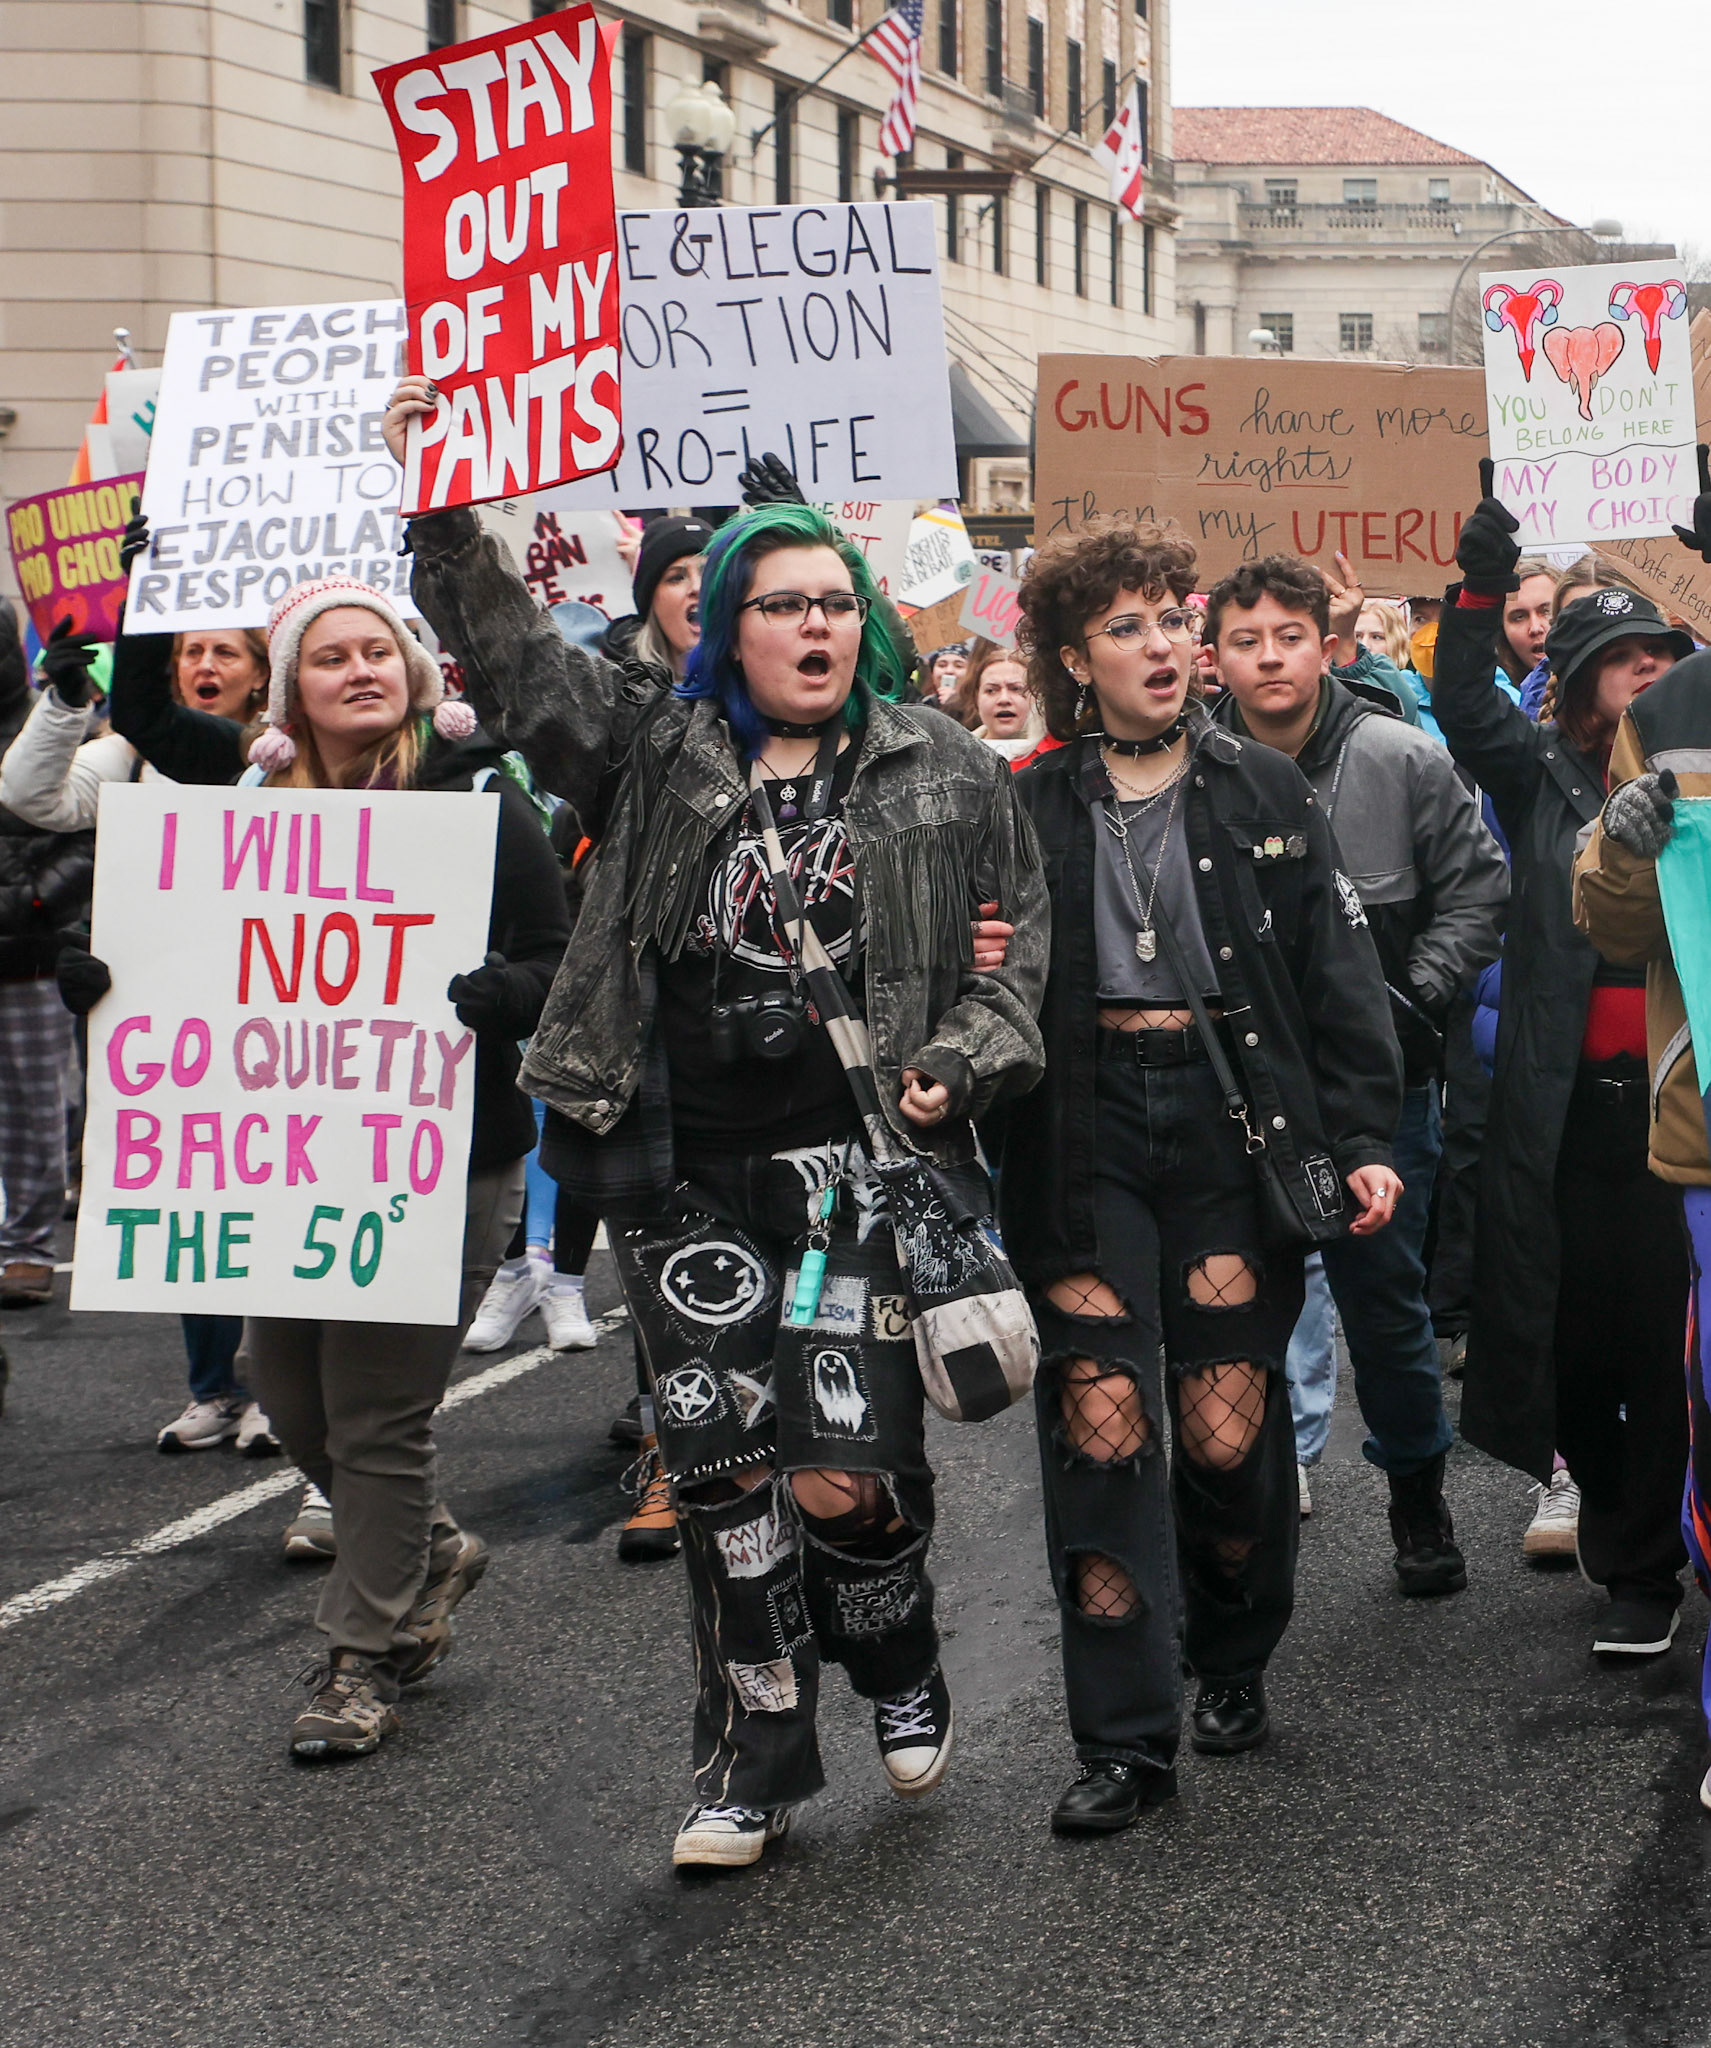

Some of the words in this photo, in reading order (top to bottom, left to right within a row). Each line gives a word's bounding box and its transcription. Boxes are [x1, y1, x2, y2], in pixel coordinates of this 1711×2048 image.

[393, 17, 595, 183] STAY
[445, 162, 568, 281] OUT
[718, 204, 932, 280] LEGAL
[197, 308, 405, 347] TEACH
[420, 285, 503, 381] OF
[529, 250, 612, 361] MY
[621, 284, 893, 369] ORTION
[200, 343, 408, 392] PEOPL
[254, 387, 358, 418] WITH
[401, 343, 620, 512] PANTS
[1055, 379, 1210, 438] GUNS
[1240, 387, 1354, 436] have
[1376, 407, 1489, 438] more
[1493, 394, 1546, 427] YOU
[1600, 380, 1678, 415] DON'T
[189, 411, 388, 466] PENISE
[1516, 424, 1604, 452] BELONG
[1623, 419, 1675, 438] HERE
[181, 472, 293, 518] HOW
[324, 463, 397, 503] TO
[1197, 445, 1352, 492] rights
[1501, 460, 1558, 500] MY
[1592, 453, 1677, 490] BODY
[9, 503, 45, 554] PRO
[47, 481, 141, 541] UNION
[149, 505, 402, 571] EJACULAT
[842, 501, 882, 521] BUT
[1199, 510, 1276, 561] my
[1292, 508, 1462, 567] UTERU
[17, 552, 53, 602] PRO
[56, 534, 127, 590] CHO
[135, 557, 412, 614] RESPONIBL
[1634, 538, 1672, 585] Safe
[1679, 574, 1711, 621] Lega
[972, 574, 1027, 638] Ug
[811, 780, 824, 803] Kodak
[158, 812, 178, 891] I
[222, 807, 394, 903] WILL
[237, 911, 436, 1006] NOT
[107, 1015, 213, 1097] GO
[233, 1016, 474, 1112] QUIETLY
[764, 1027, 785, 1043] Kodak
[113, 1108, 324, 1191] BACK
[361, 1113, 444, 1196] TO
[105, 1207, 255, 1284] THE
[736, 1661, 781, 1686] EAT
